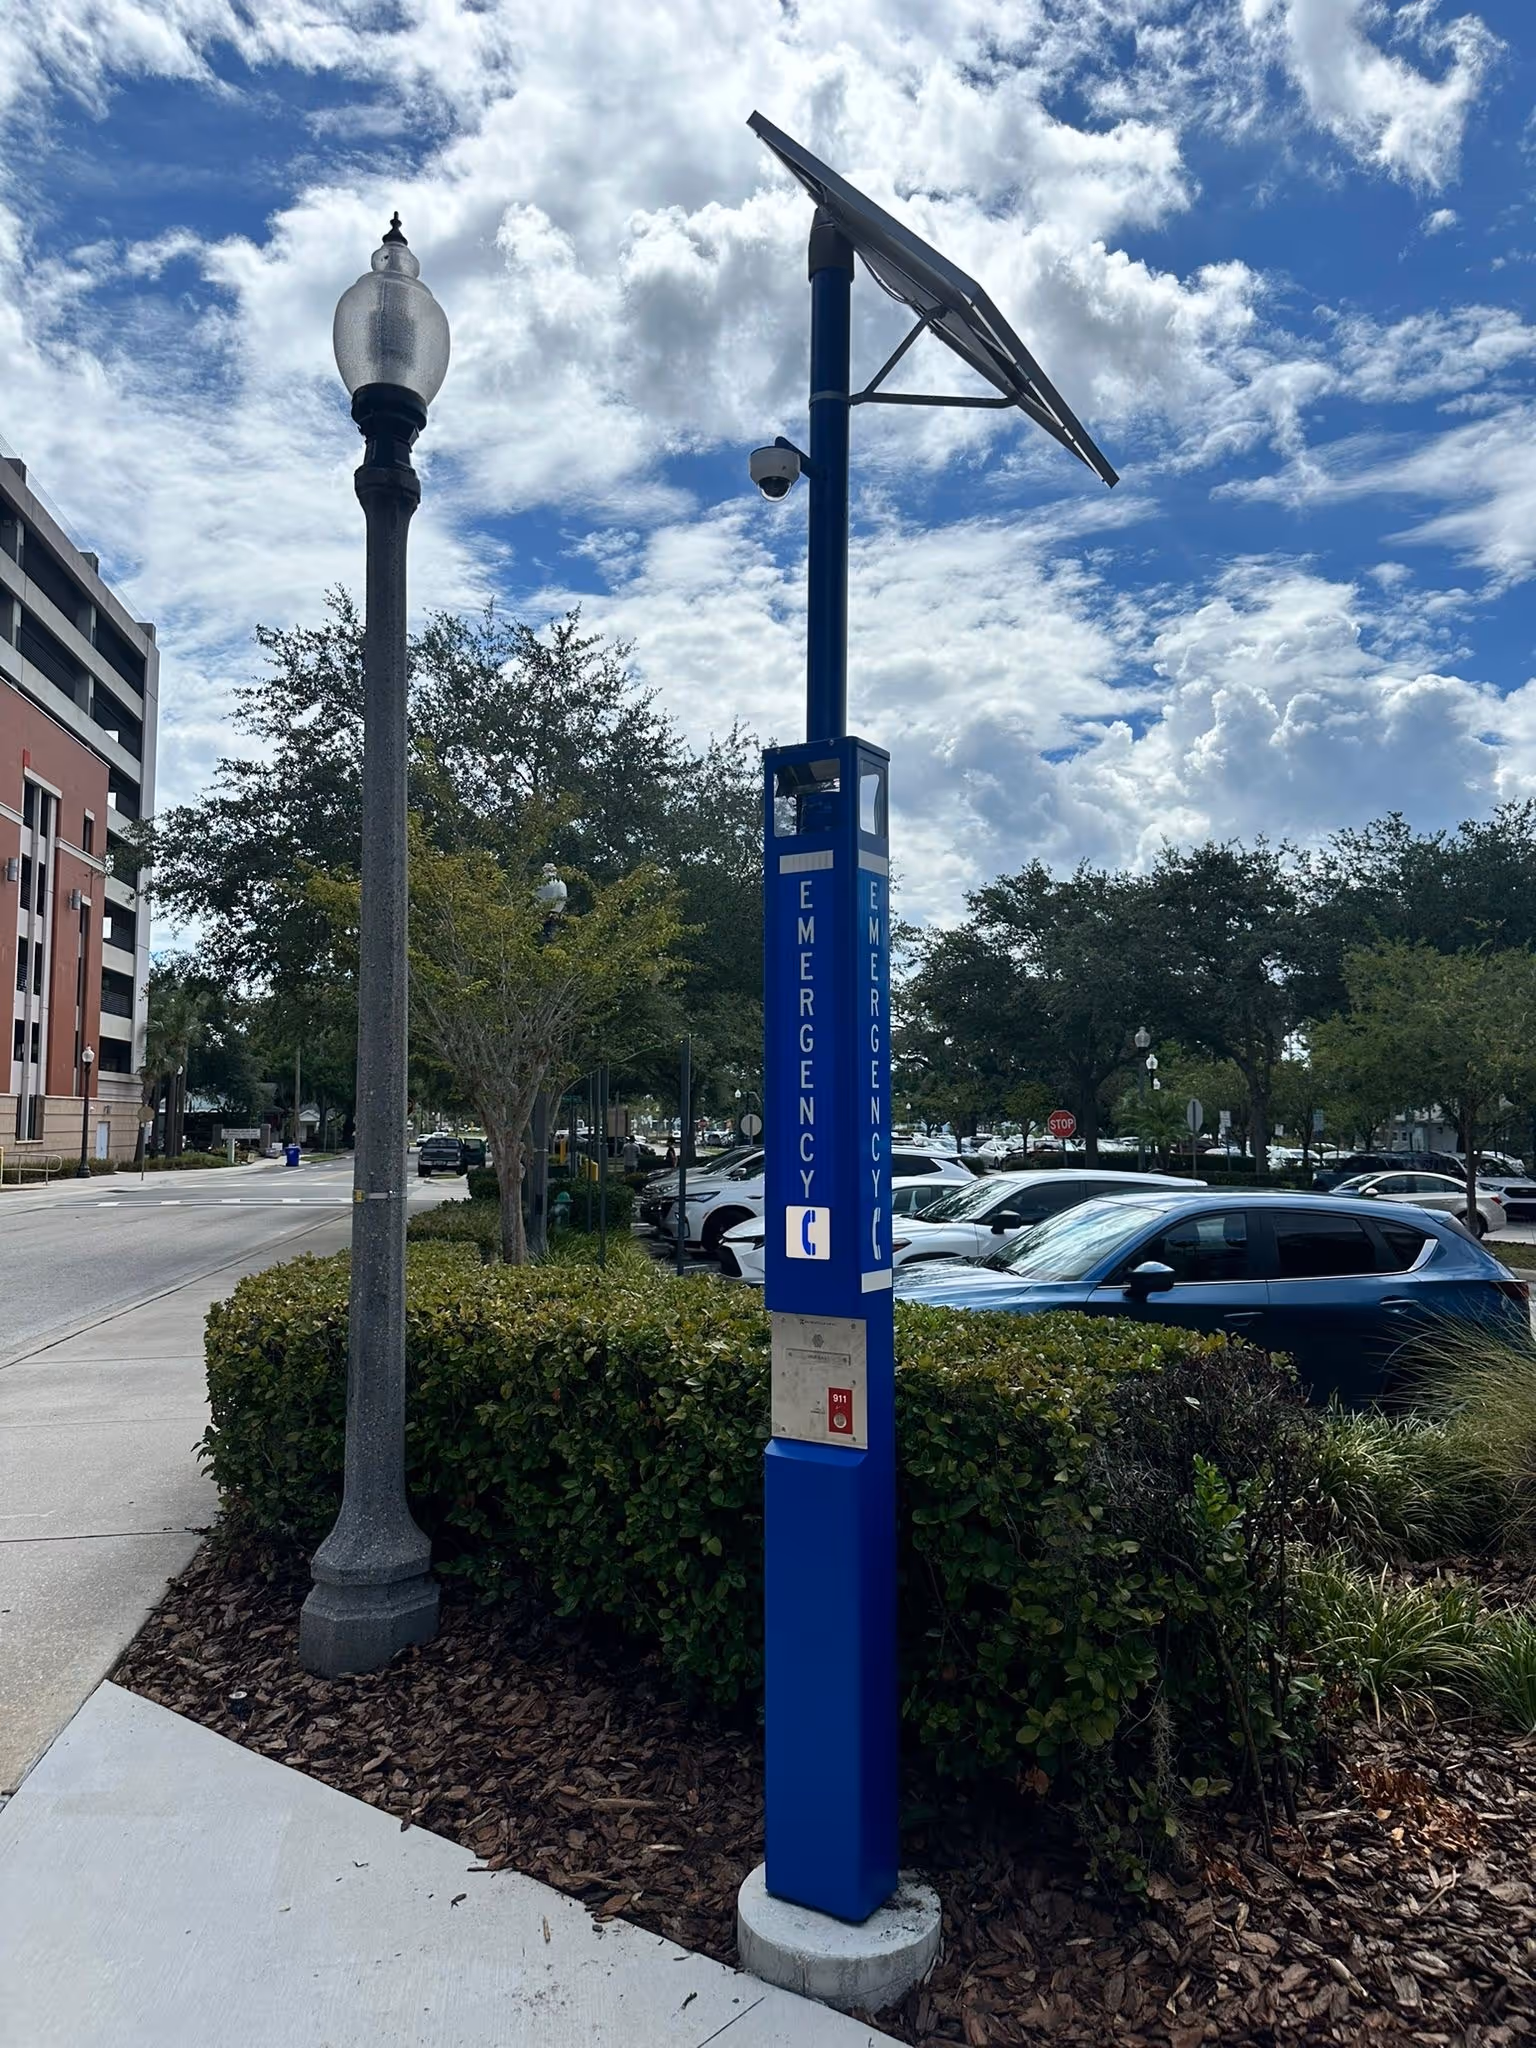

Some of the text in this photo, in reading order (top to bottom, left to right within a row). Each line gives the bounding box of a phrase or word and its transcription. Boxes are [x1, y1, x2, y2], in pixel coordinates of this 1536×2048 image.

[797, 880, 815, 1199] EMERGENCY
[868, 881, 881, 1199] EMERGENCY
[1050, 1118, 1074, 1130] STOP
[832, 1393, 847, 1403] 911
